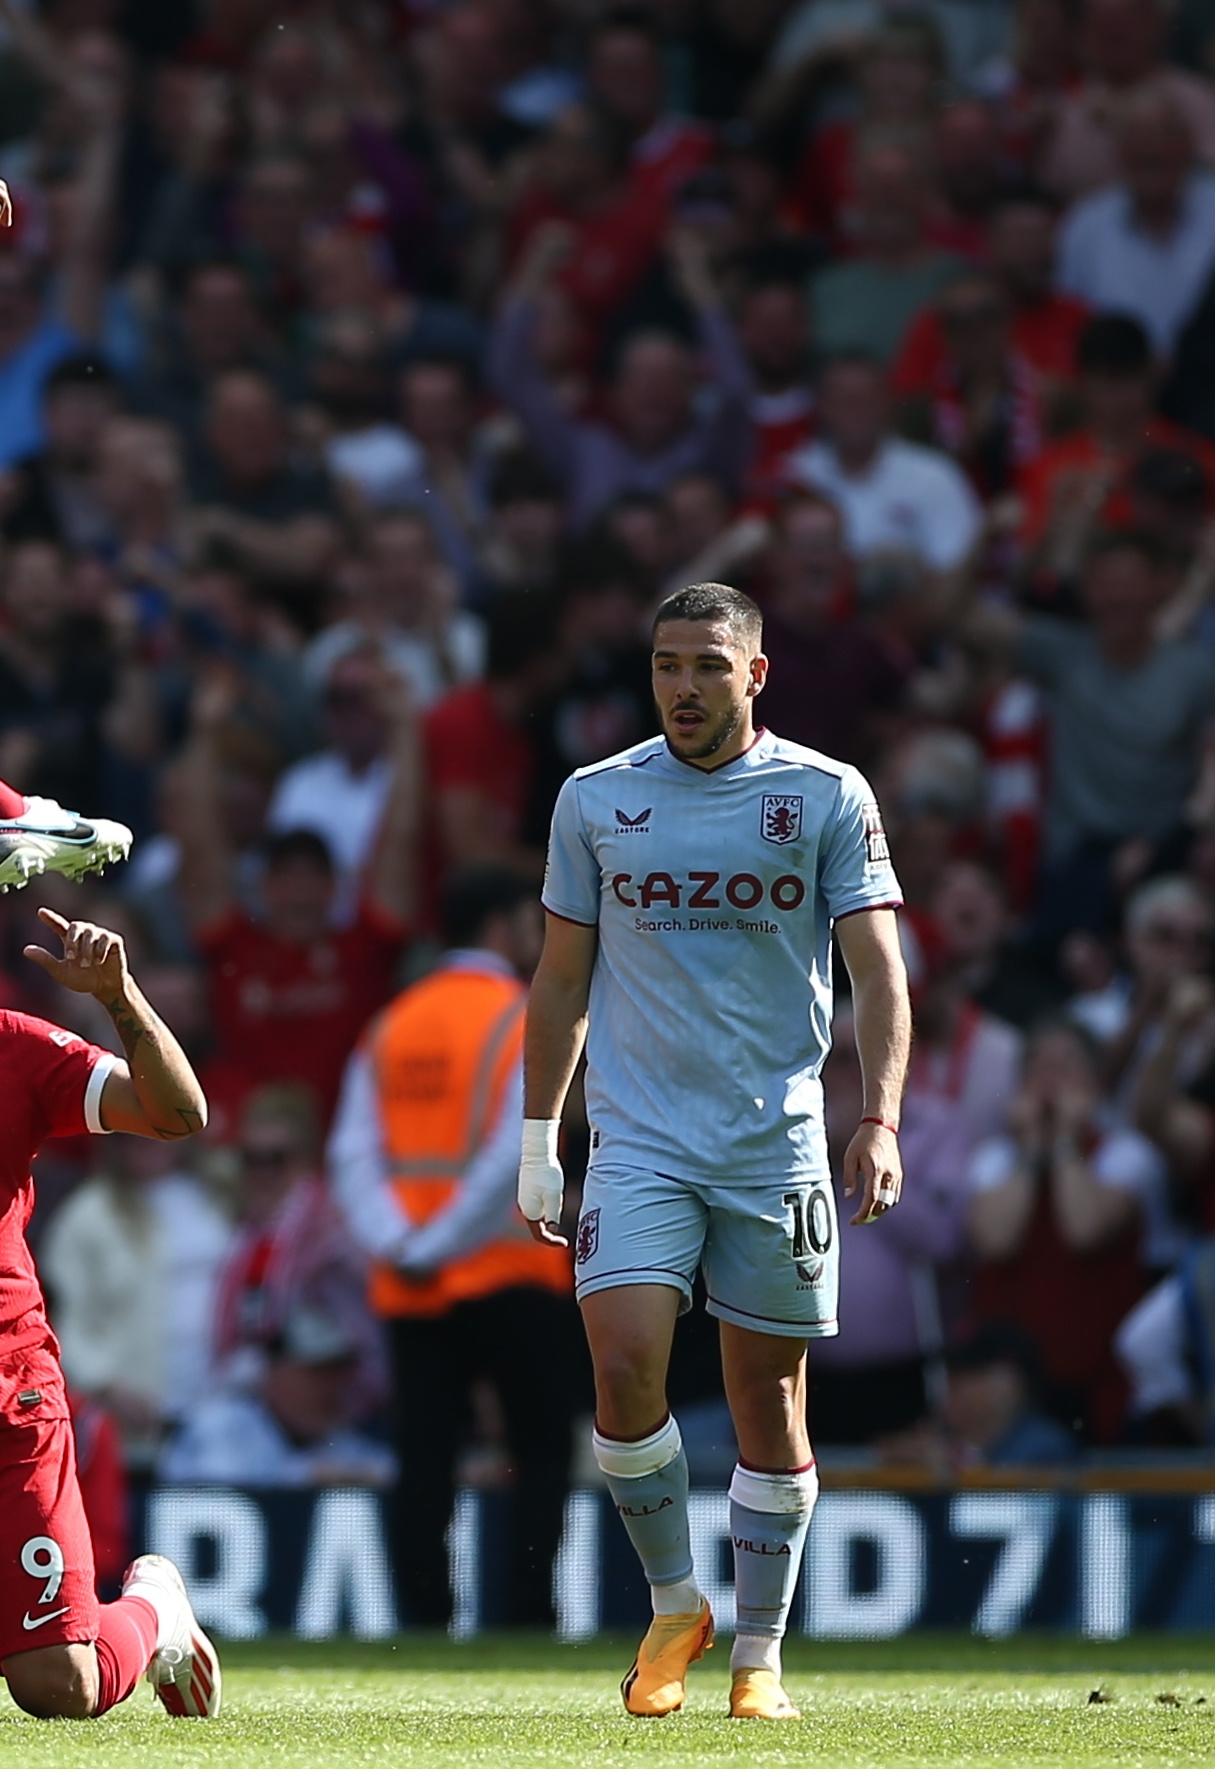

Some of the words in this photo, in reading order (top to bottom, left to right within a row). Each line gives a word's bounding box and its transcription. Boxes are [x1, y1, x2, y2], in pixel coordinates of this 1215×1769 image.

[612, 871, 805, 912] CAZOO
[634, 917, 686, 932] Search.
[688, 918, 734, 931] Drive.
[735, 918, 783, 935] Smile.
[783, 1188, 834, 1259] 10
[733, 1535, 792, 1556] VILLA
[20, 1536, 65, 1605] 9
